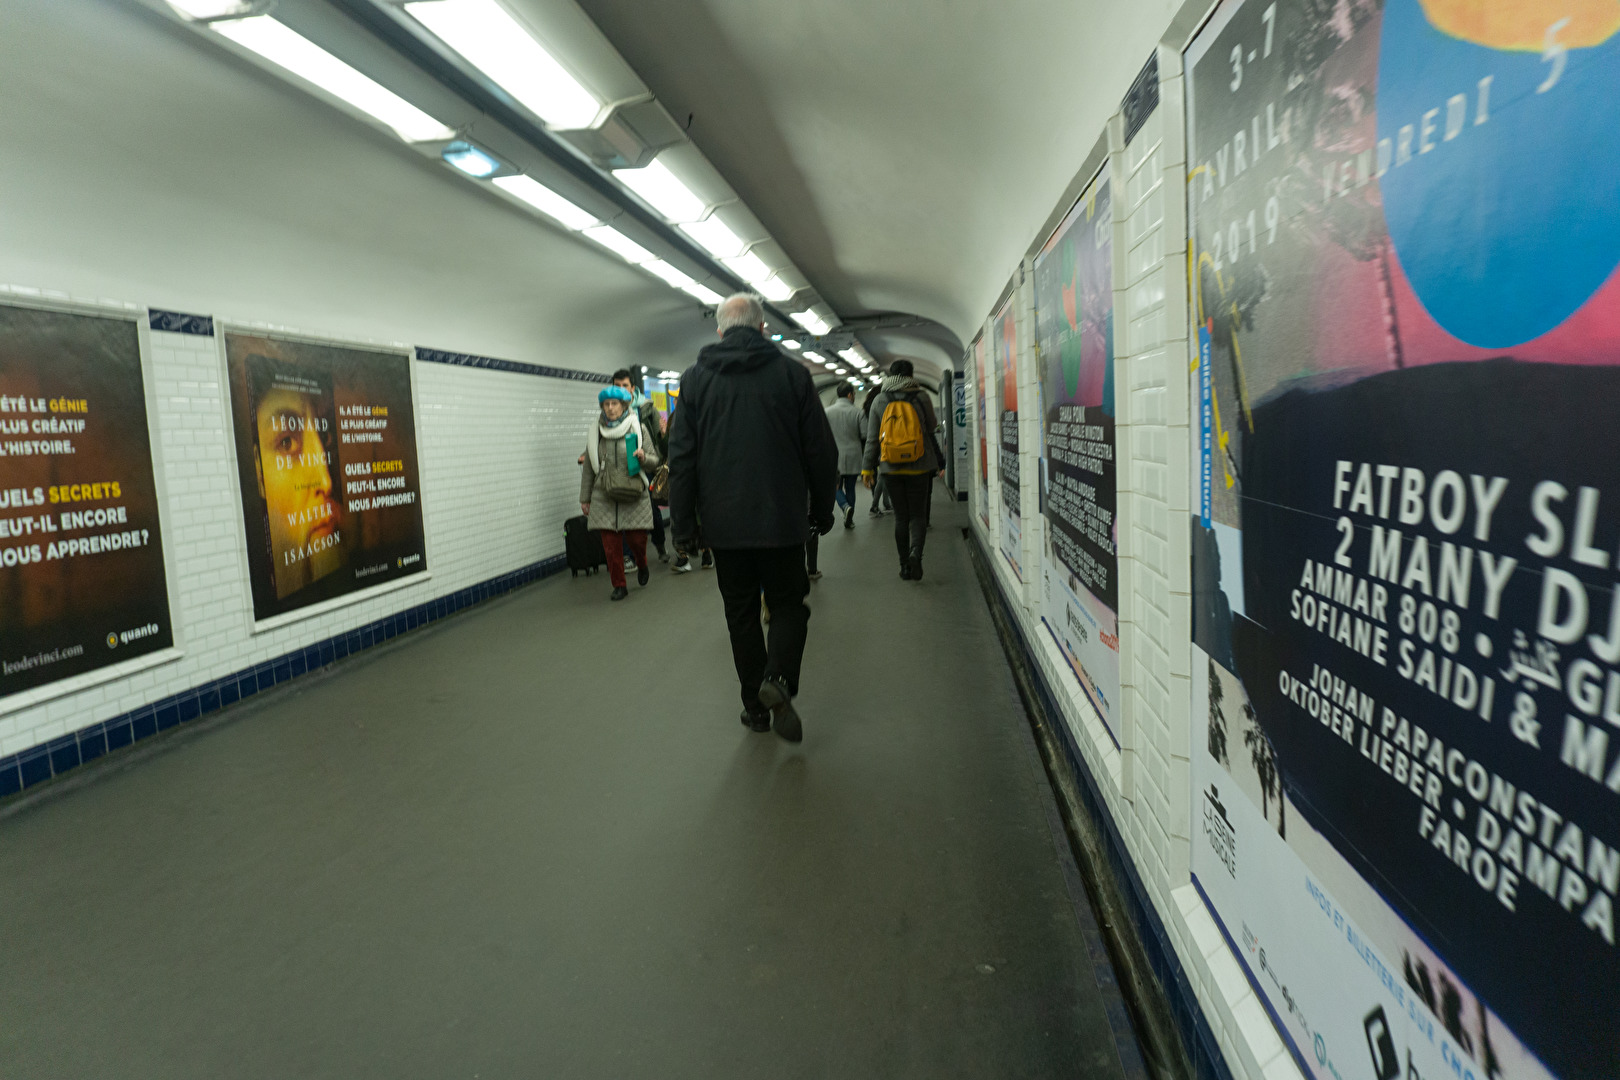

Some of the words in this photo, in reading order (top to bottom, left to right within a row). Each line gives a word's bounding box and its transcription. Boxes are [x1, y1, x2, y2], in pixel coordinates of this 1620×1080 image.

[1229, 1, 1277, 93] 3-7
[1323, 74, 1494, 205] VENDREDI
[1536, 16, 1572, 95] 5
[1201, 102, 1280, 203] AVRIL
[1212, 196, 1279, 272] 2019
[1, 394, 27, 413] ÉTÉ
[30, 398, 47, 413] LE
[49, 396, 88, 413] GÉNIE
[346, 405, 352, 416] A
[364, 405, 371, 416] LE
[32, 416, 86, 434] CRÉATIF
[271, 413, 328, 432] LÉONARD
[341, 419, 348, 430] LE
[349, 419, 364, 430] PLUS
[342, 433, 350, 443] DE
[276, 454, 293, 471] DE
[299, 451, 332, 468] VINCI
[345, 462, 371, 476] QUELS
[372, 460, 403, 474] SECRETS
[49, 481, 121, 504] SECRETS
[346, 480, 376, 494] PEUT-IL
[377, 476, 405, 491] ENCORE
[60, 506, 127, 531] ENCORE
[287, 502, 333, 527] WALTER
[348, 497, 370, 512] NOUS
[1333, 460, 1510, 542] FATBOY
[1524, 480, 1620, 570] SL
[284, 530, 341, 566] ISAACSON
[1300, 558, 1389, 624] AMMAR
[1398, 593, 1461, 654] 808
[1334, 516, 1355, 569] 2
[1368, 524, 1518, 621] MANY
[1536, 566, 1620, 665] DJ
[120, 622, 159, 645] quanto
[3, 644, 84, 676] leodevinci.com
[1290, 588, 1389, 667] SOFIANE
[1396, 638, 1496, 723] SAIDI
[1509, 691, 1542, 750] &
[1309, 663, 1375, 727] JOHAN
[1381, 706, 1620, 898] PAPACONSTAN
[1279, 670, 1354, 747] OKTOBER
[1360, 726, 1443, 813] LIEBER
[1476, 807, 1615, 946] DAMPA
[1203, 819, 1235, 880] MUSICALE
[1418, 804, 1520, 912] FAROE
[1306, 875, 1331, 919] INFOS
[1333, 908, 1345, 933] ET
[1346, 924, 1405, 1008] BILLETTERIE
